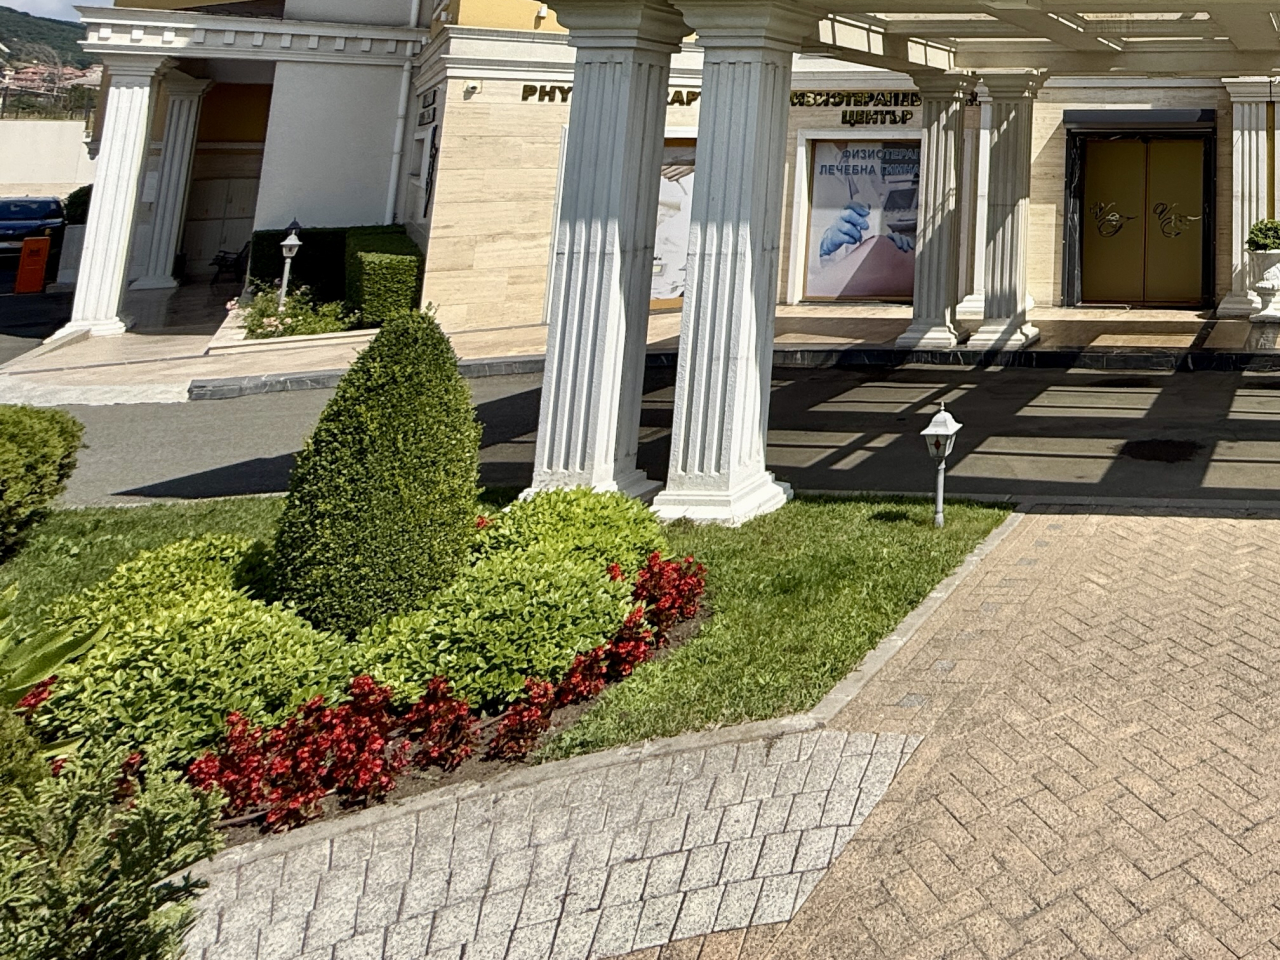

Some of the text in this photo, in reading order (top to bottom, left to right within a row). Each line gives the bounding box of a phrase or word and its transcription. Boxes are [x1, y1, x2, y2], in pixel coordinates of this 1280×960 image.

[841, 110, 914, 127] ЦЕНТЪР
[842, 149, 921, 160] ФИЗИОТЕРАП
[819, 164, 920, 176] ЛЕЧЕБНА ГИМНА
